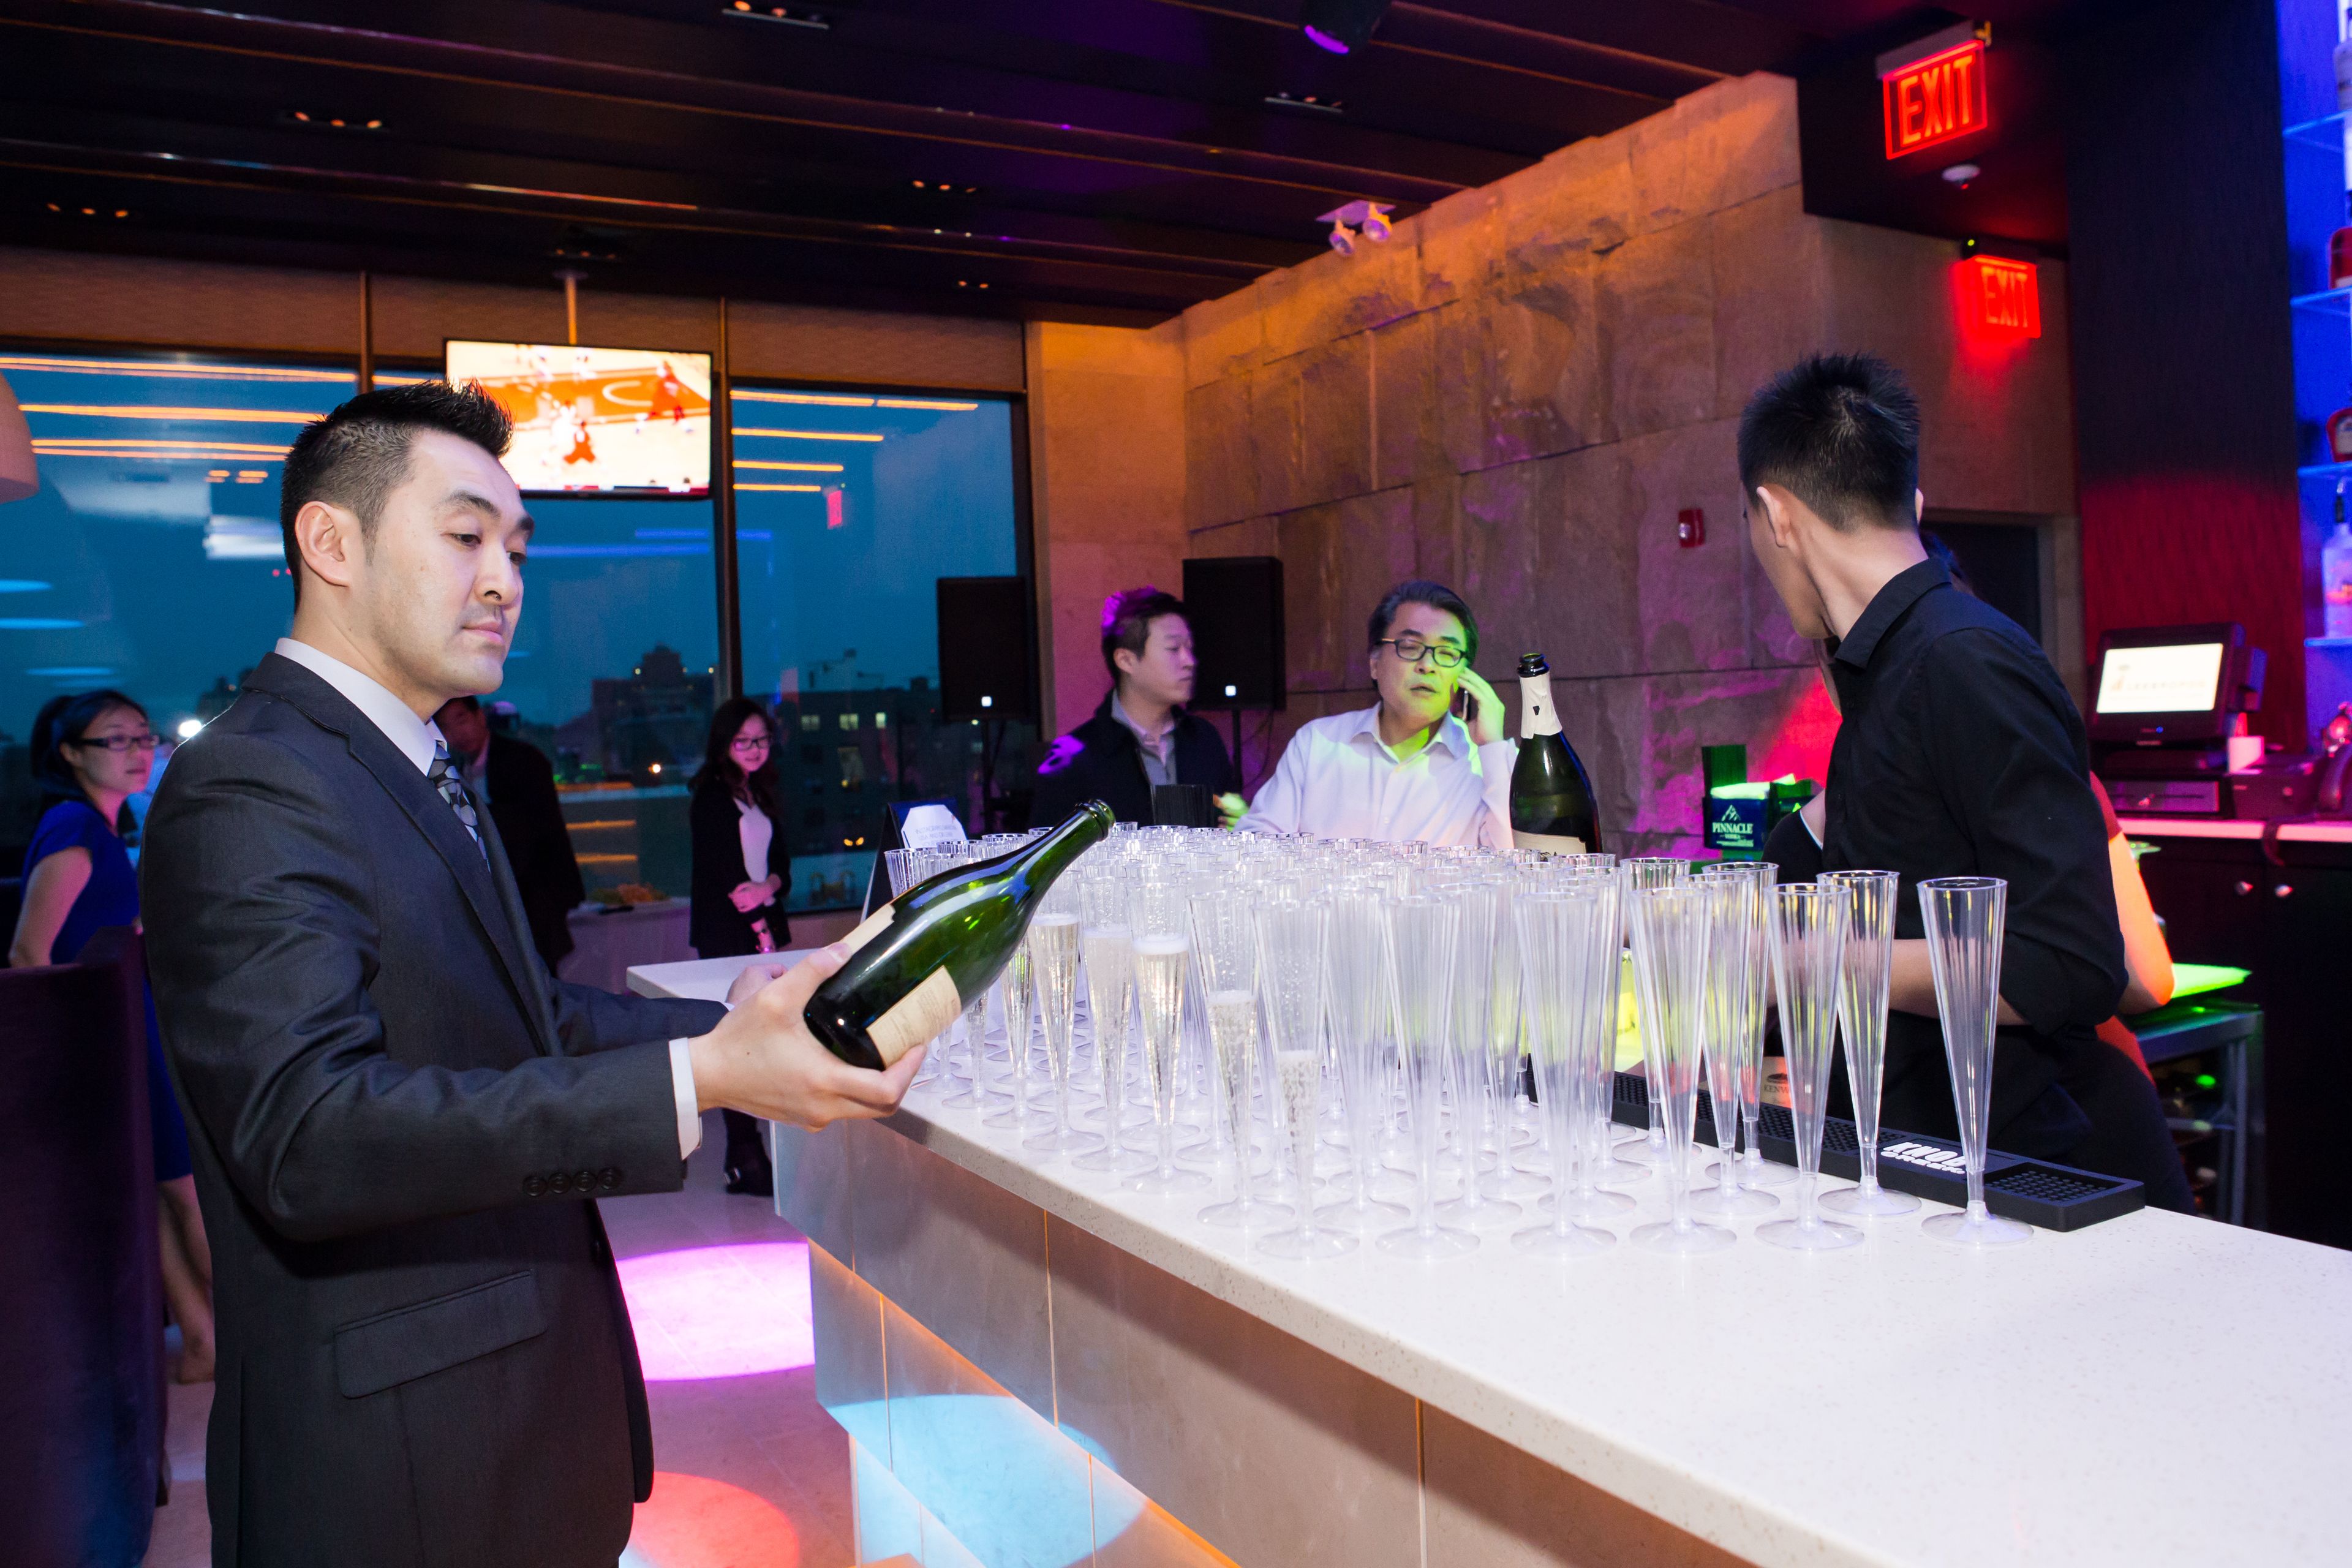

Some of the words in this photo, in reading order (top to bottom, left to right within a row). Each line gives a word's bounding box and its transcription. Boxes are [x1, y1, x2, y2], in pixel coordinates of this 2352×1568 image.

[1899, 54, 1974, 146] EXIT
[1981, 265, 2029, 328] EXIT
[1712, 822, 1754, 834] PINNACLE
[1764, 1085, 1789, 1093] KENW
